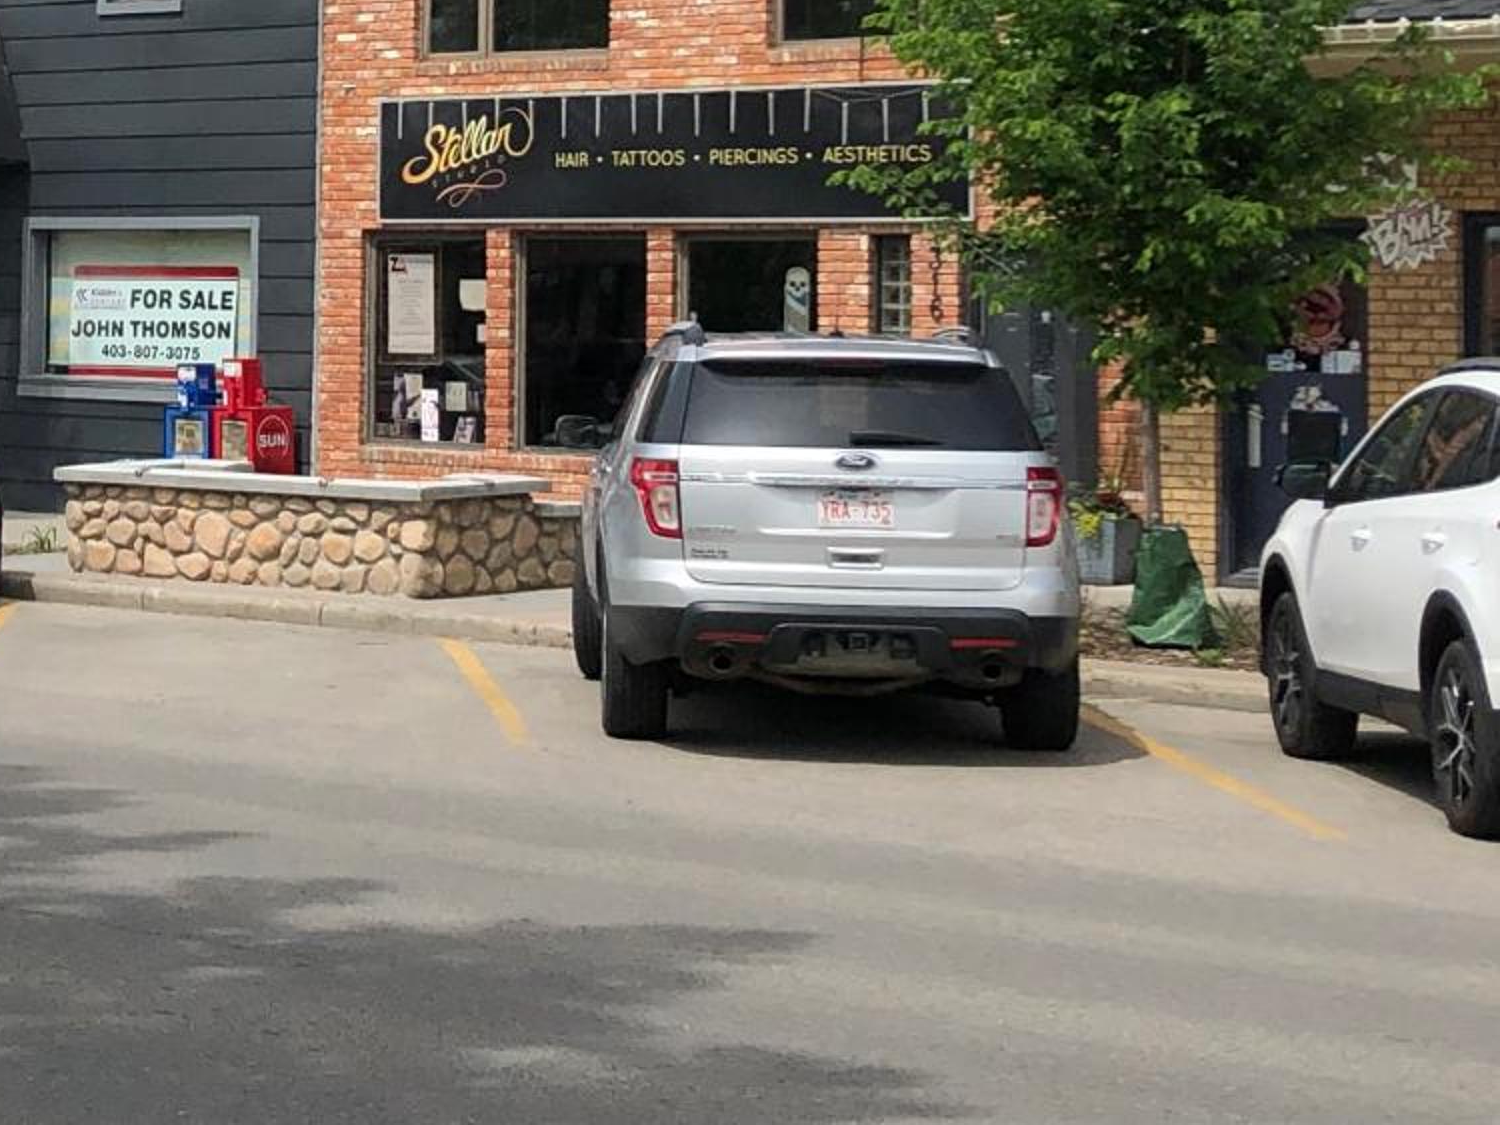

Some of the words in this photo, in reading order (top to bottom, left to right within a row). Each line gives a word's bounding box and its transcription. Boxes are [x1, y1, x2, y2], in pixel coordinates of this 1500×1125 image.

[402, 107, 533, 184] Stellar
[555, 152, 589, 168] HAIR
[611, 149, 685, 166] TATTOOS
[708, 146, 799, 166] PIERCINGS
[822, 144, 932, 163] AESTHETICS
[130, 288, 173, 310] FOR
[178, 289, 235, 311] SALE
[71, 320, 125, 338] JOHN
[129, 320, 231, 340] THOMSON
[101, 344, 201, 361] 403-807-3075
[259, 433, 286, 448] SUN
